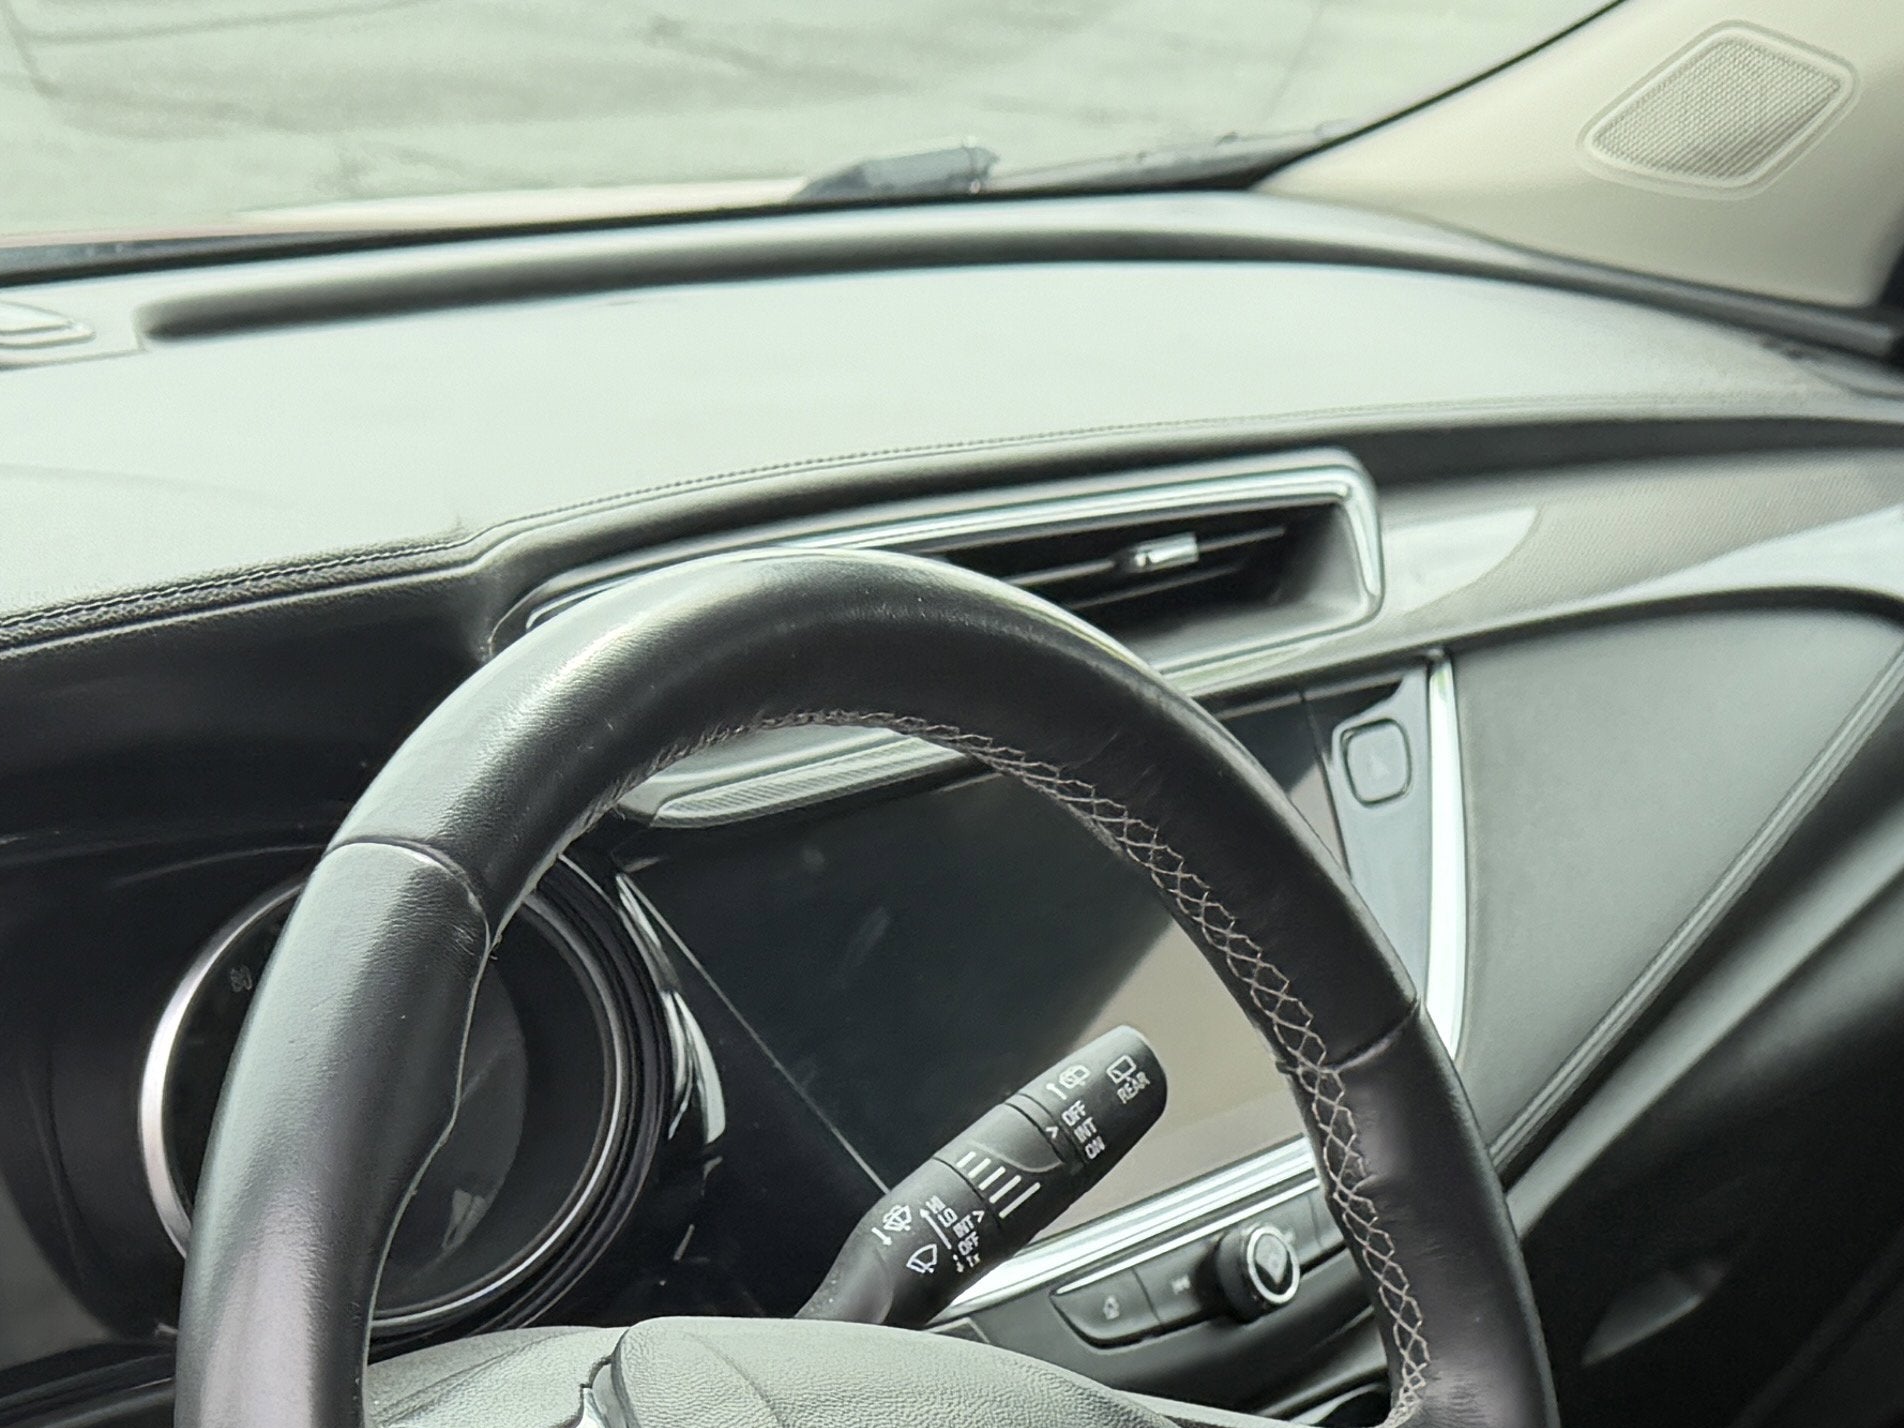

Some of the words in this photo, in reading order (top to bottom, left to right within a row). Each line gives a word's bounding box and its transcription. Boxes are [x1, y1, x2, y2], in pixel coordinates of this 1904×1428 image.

[1116, 1071, 1151, 1105] REAR
[1061, 1100, 1087, 1127] OFF
[1074, 1116, 1097, 1143] INT
[1084, 1136, 1106, 1160] ON
[952, 1214, 975, 1239] INT
[957, 1231, 979, 1256] OFF
